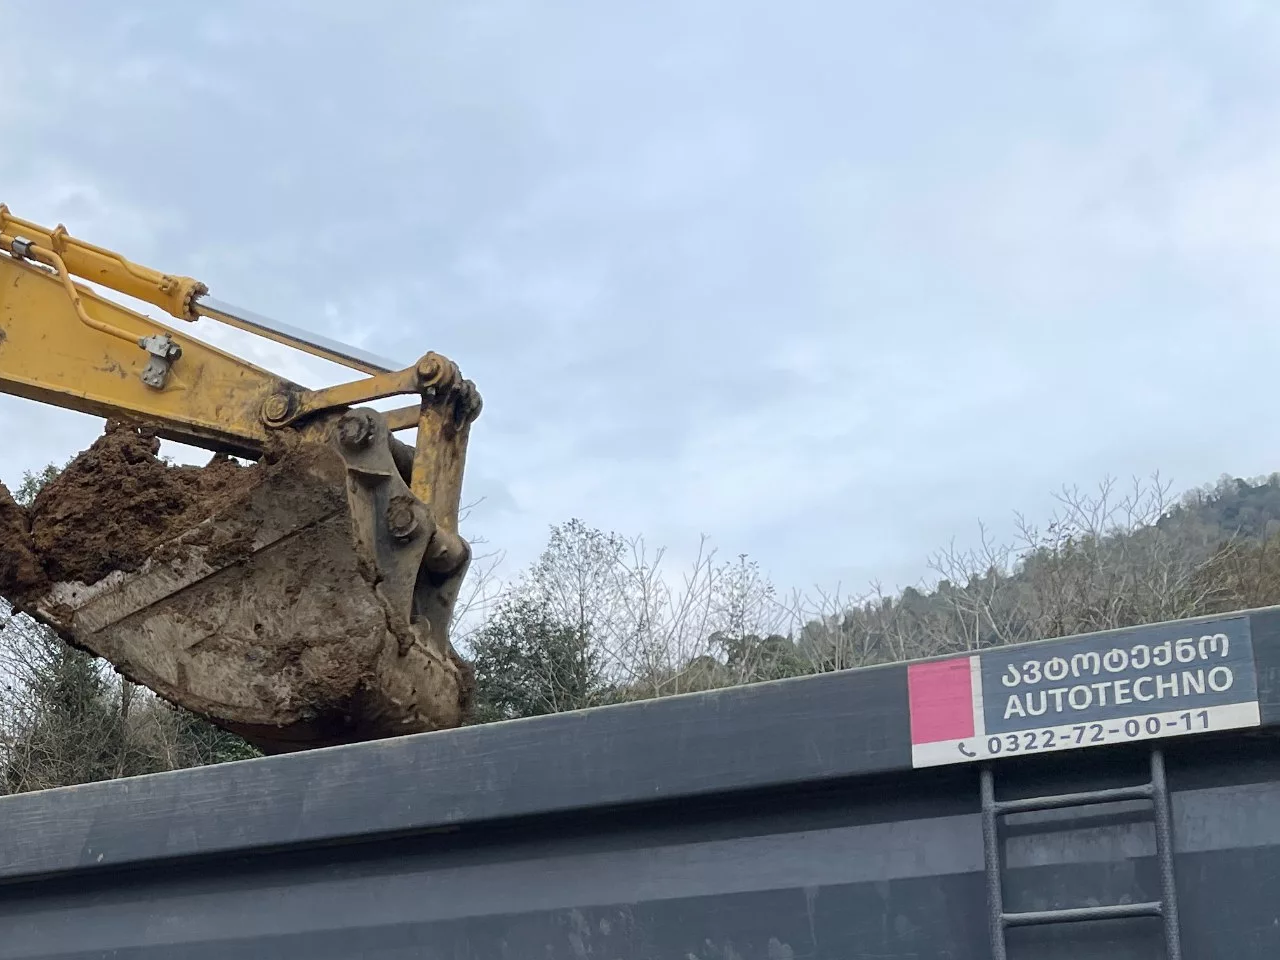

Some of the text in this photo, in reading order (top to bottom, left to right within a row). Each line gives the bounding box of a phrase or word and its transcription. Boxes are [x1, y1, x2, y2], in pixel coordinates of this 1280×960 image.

[1001, 632, 1230, 688] ავტოტექნო
[1003, 666, 1234, 720] AUTOTECHNO
[987, 710, 1210, 754] 0322-72-00-11
